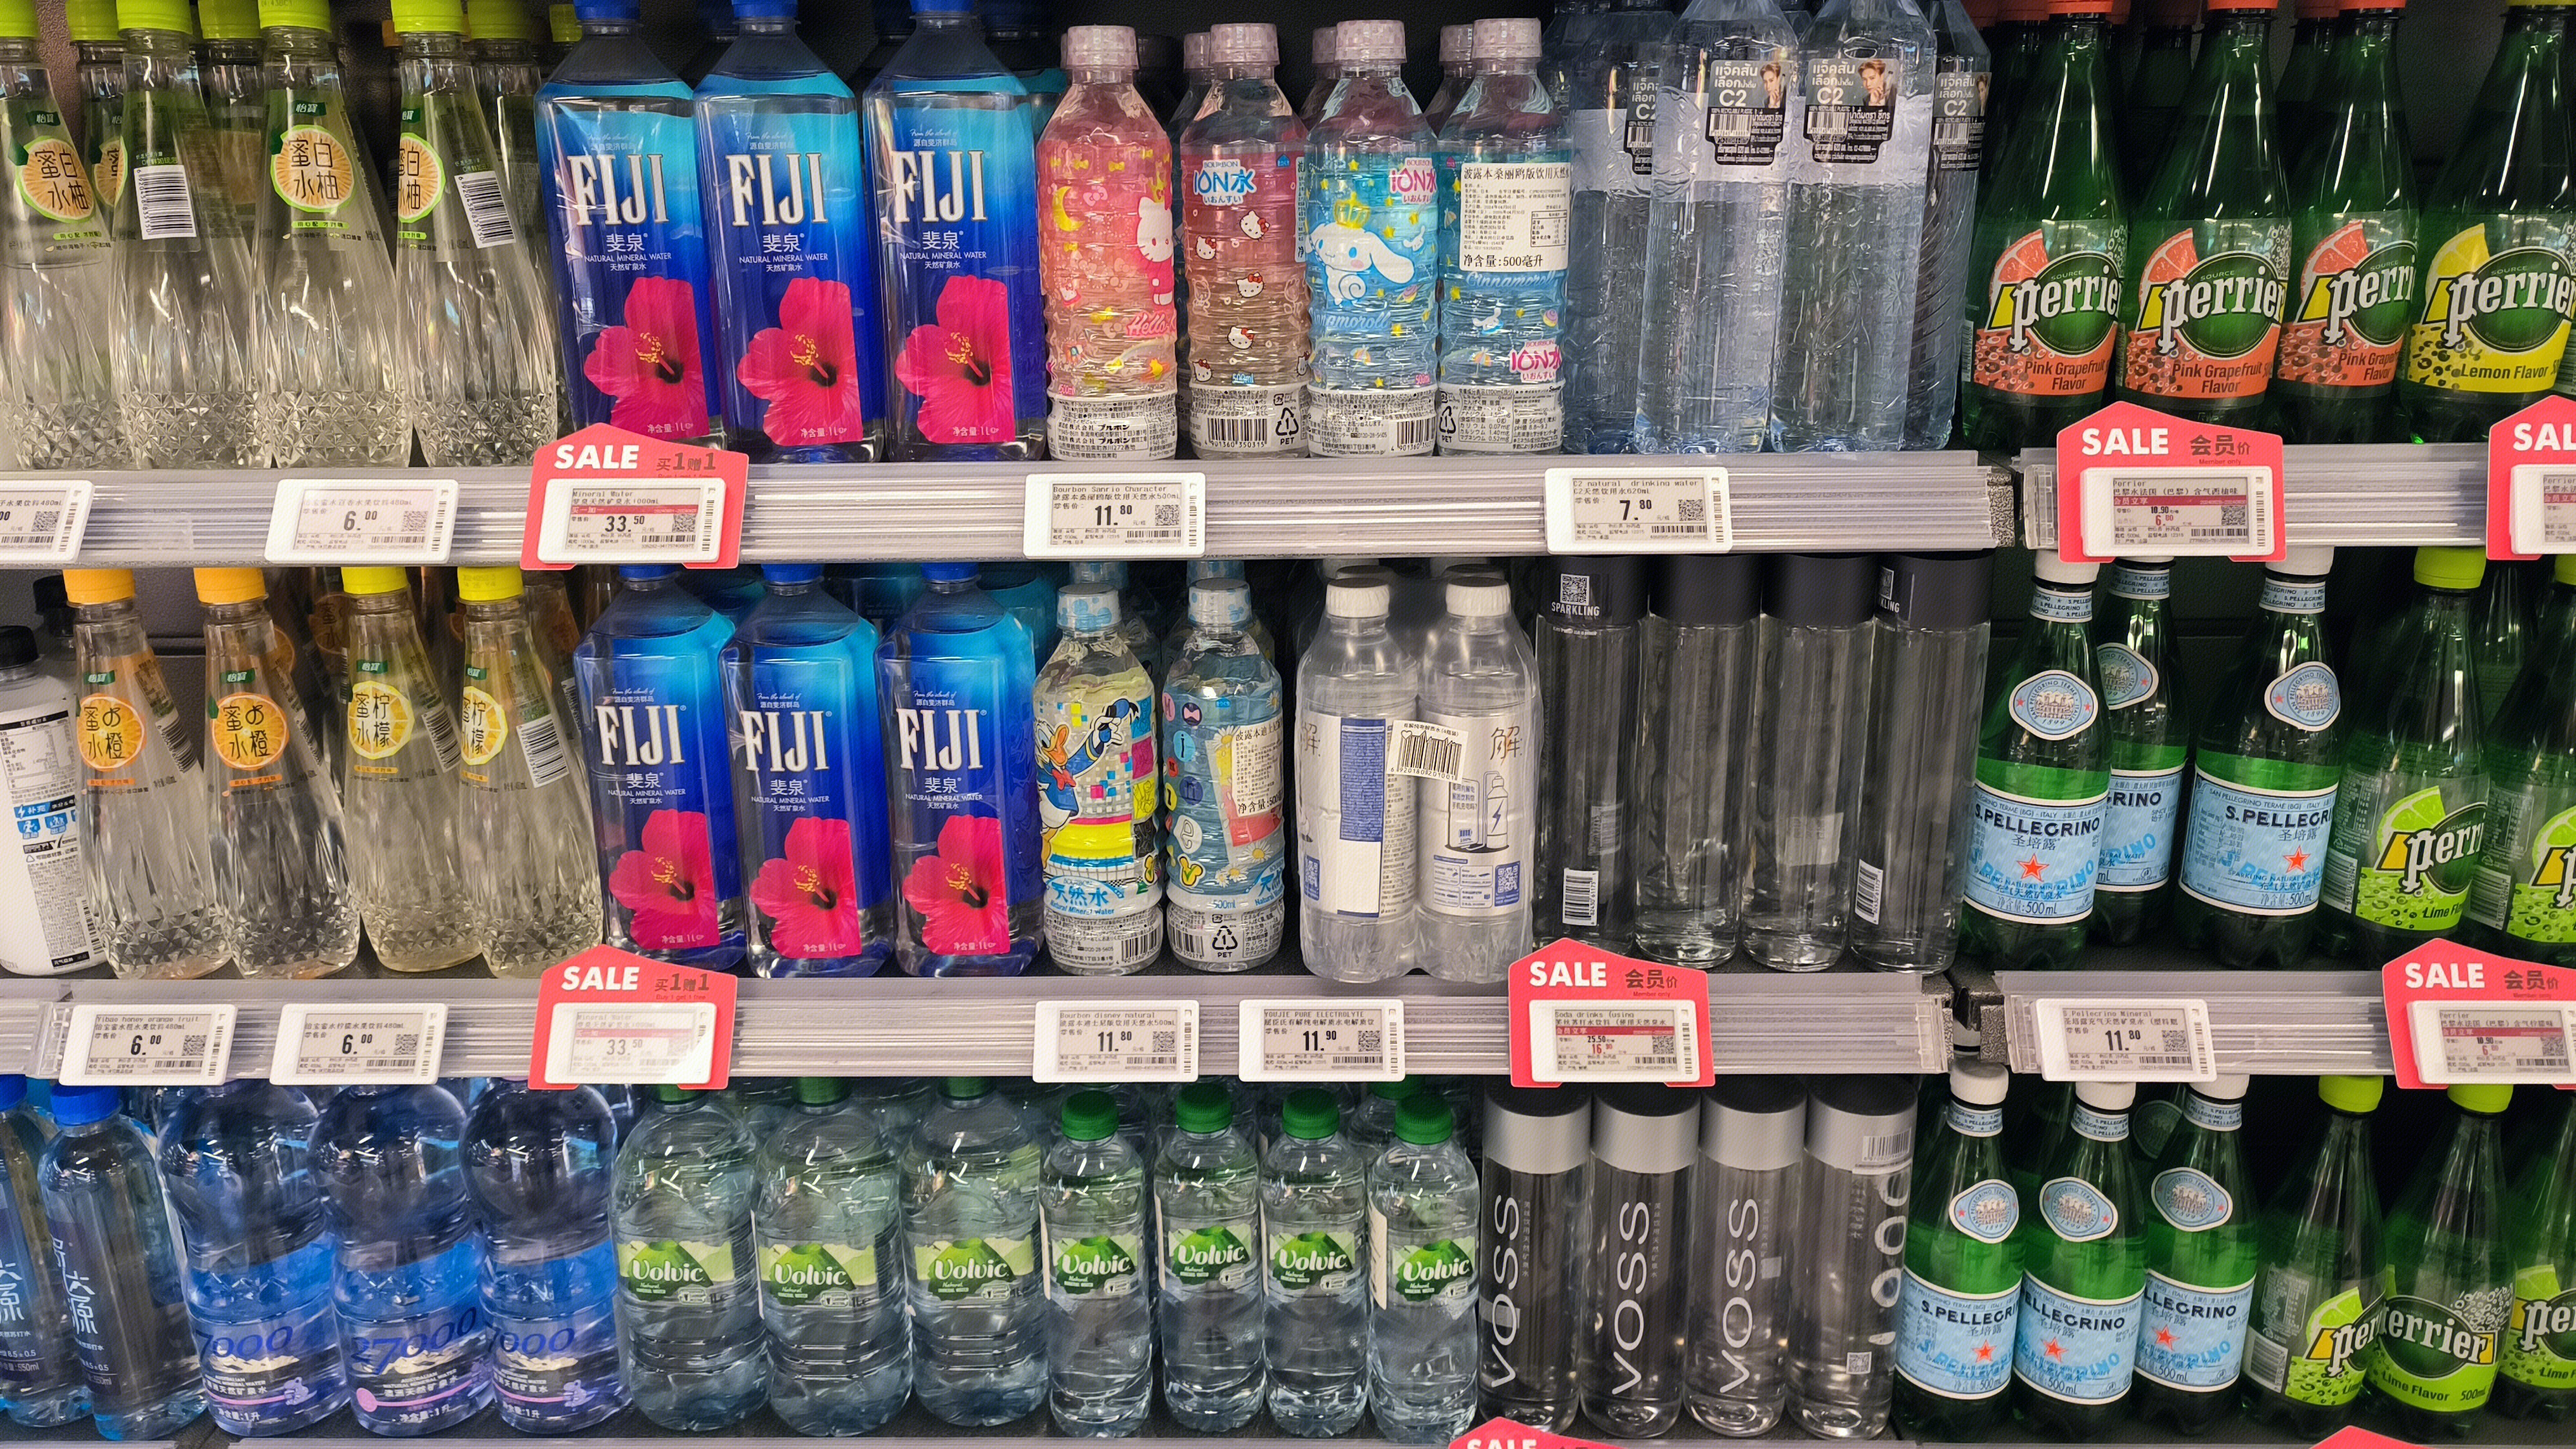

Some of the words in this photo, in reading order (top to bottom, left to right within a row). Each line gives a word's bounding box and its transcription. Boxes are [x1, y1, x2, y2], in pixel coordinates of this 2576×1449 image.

[1719, 89, 1747, 107] C2
[1817, 87, 1844, 105] C2
[1944, 99, 1967, 117] C2
[567, 153, 670, 225] FIJI
[725, 153, 828, 226] FIJI
[892, 150, 988, 223] FIJI
[1194, 169, 1256, 194] ION水
[1203, 195, 1243, 204] いおんすい
[606, 232, 645, 252] 斐泉
[763, 233, 802, 253] 斐泉
[922, 230, 961, 250] 斐泉
[617, 254, 648, 262] MINERAL
[649, 252, 672, 260] WATER
[924, 260, 961, 269] 天然矿泉水
[932, 251, 962, 260] MINERAL
[964, 251, 987, 259] WATER
[1463, 254, 1543, 267] 净含量:500毫升
[2370, 260, 2399, 271] SOURCE
[610, 263, 647, 271] 天然矿泉水
[766, 263, 802, 272] 天然矿泉水
[2051, 270, 2083, 281] SOURCE
[2200, 270, 2235, 281] SOURCE
[2491, 265, 2528, 276] SOURCE
[2338, 351, 2365, 366] Pink
[2025, 361, 2051, 375] Pink
[2055, 360, 2105, 378] Grapefruit
[2172, 363, 2201, 378] Pink
[2205, 362, 2262, 380] Grapefruit
[2364, 367, 2392, 381] Flavor
[2460, 363, 2511, 380] Lemon
[2514, 362, 2549, 380] Flavor
[2052, 376, 2086, 391] Flavor
[2201, 378, 2239, 393] Flavor
[1280, 436, 1294, 445] PET
[2081, 427, 2169, 456] SALE
[2190, 434, 2251, 456] 会员价
[553, 444, 639, 470] SALE
[656, 452, 716, 471] 买1赠1
[1095, 504, 1132, 526] 11.80
[1618, 499, 1652, 521] 7.80
[1551, 601, 1600, 617] SPARKLING
[595, 705, 686, 765] FIJI
[740, 710, 830, 772] FIJI
[896, 708, 984, 771] FIJI
[626, 773, 661, 789] 斐泉
[924, 777, 958, 793] 斐泉
[1428, 771, 1455, 780] 201001
[770, 779, 804, 796] 斐泉
[961, 793, 984, 801] WATER
[751, 796, 777, 804] NATURAL
[2264, 800, 2286, 810] TERME
[1974, 803, 2100, 837] S.PELLEGRINO
[2011, 834, 2057, 851] 圣培露
[2277, 828, 2318, 842] 圣培露
[2423, 905, 2449, 920] Lime
[560, 965, 640, 991] SALE
[654, 973, 710, 992] 买1赠1
[1530, 961, 1607, 987] SALE
[1625, 969, 1678, 989] 会员价
[2405, 962, 2485, 989] SALE
[2503, 970, 2558, 990] 会员价
[130, 1035, 162, 1056] 6.00
[341, 1034, 373, 1055] 6.00
[1097, 1031, 1132, 1052] 11.80
[1302, 1030, 1337, 1051] 11.90
[2105, 1030, 2141, 1051] 11.80
[1062, 1252, 1130, 1276] Volvic
[1178, 1243, 1245, 1266] Volvic
[1279, 1249, 1348, 1271] Volvic
[632, 1258, 704, 1283] Volvic
[774, 1262, 847, 1286] Volvic
[934, 1258, 1008, 1282] Volvic
[1402, 1258, 1470, 1282] Volvic
[1492, 1195, 1520, 1388] VOSS
[1612, 1201, 1650, 1395] VOSS
[1720, 1198, 1759, 1393] VOSS
[2382, 1372, 2409, 1392] Lime
[2411, 1384, 2450, 1402] Flavor
